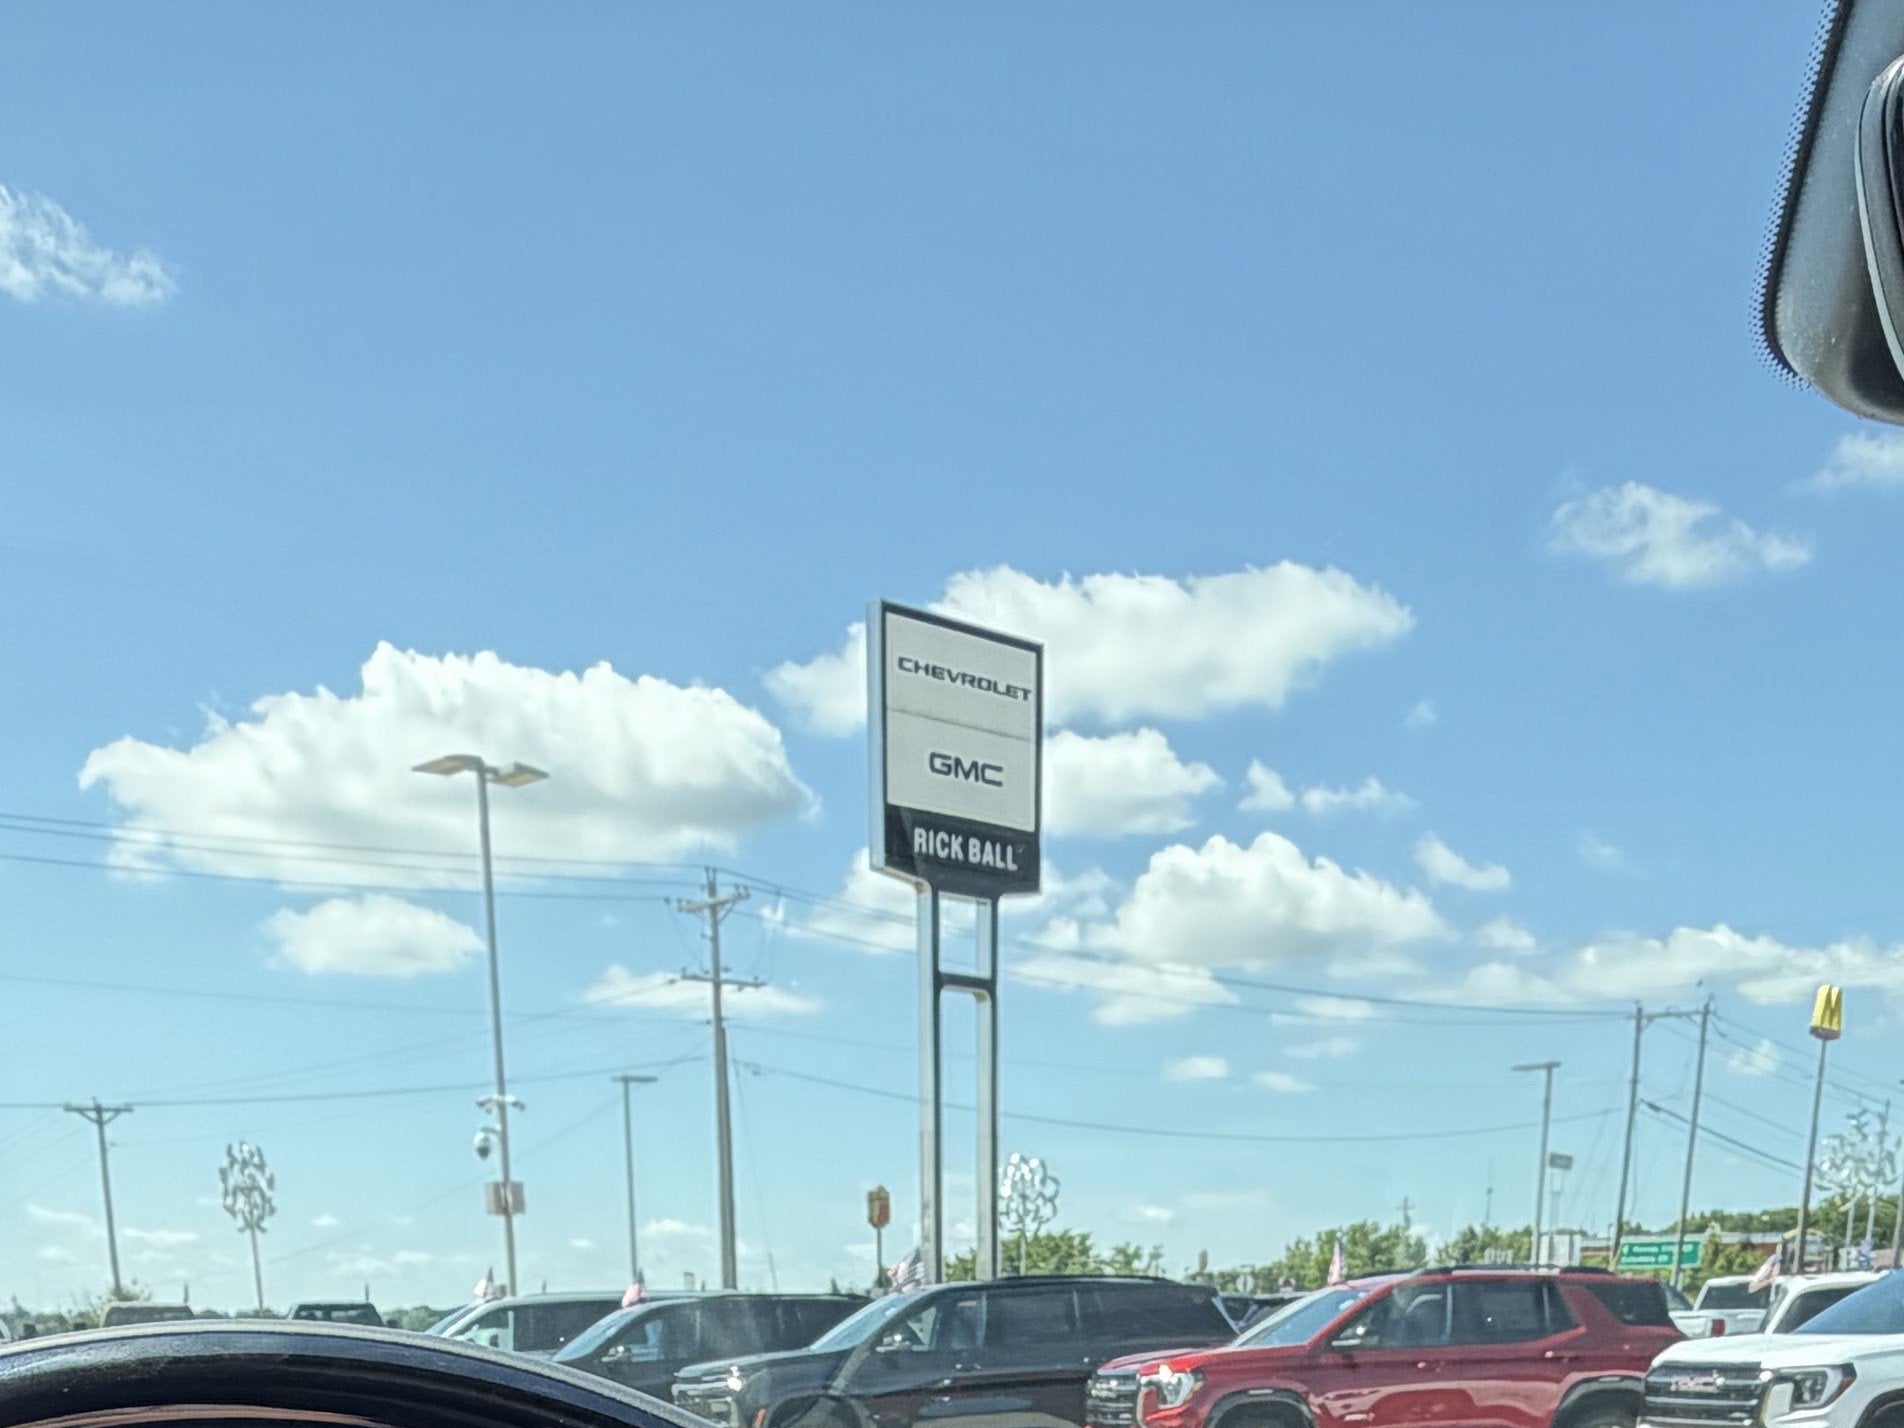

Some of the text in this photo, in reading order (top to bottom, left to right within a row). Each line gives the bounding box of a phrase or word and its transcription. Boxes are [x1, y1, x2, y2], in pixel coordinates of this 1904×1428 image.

[898, 655, 1033, 702] CHEVROLET
[929, 751, 1004, 788] GMC
[913, 827, 1019, 872] RICK BALL
